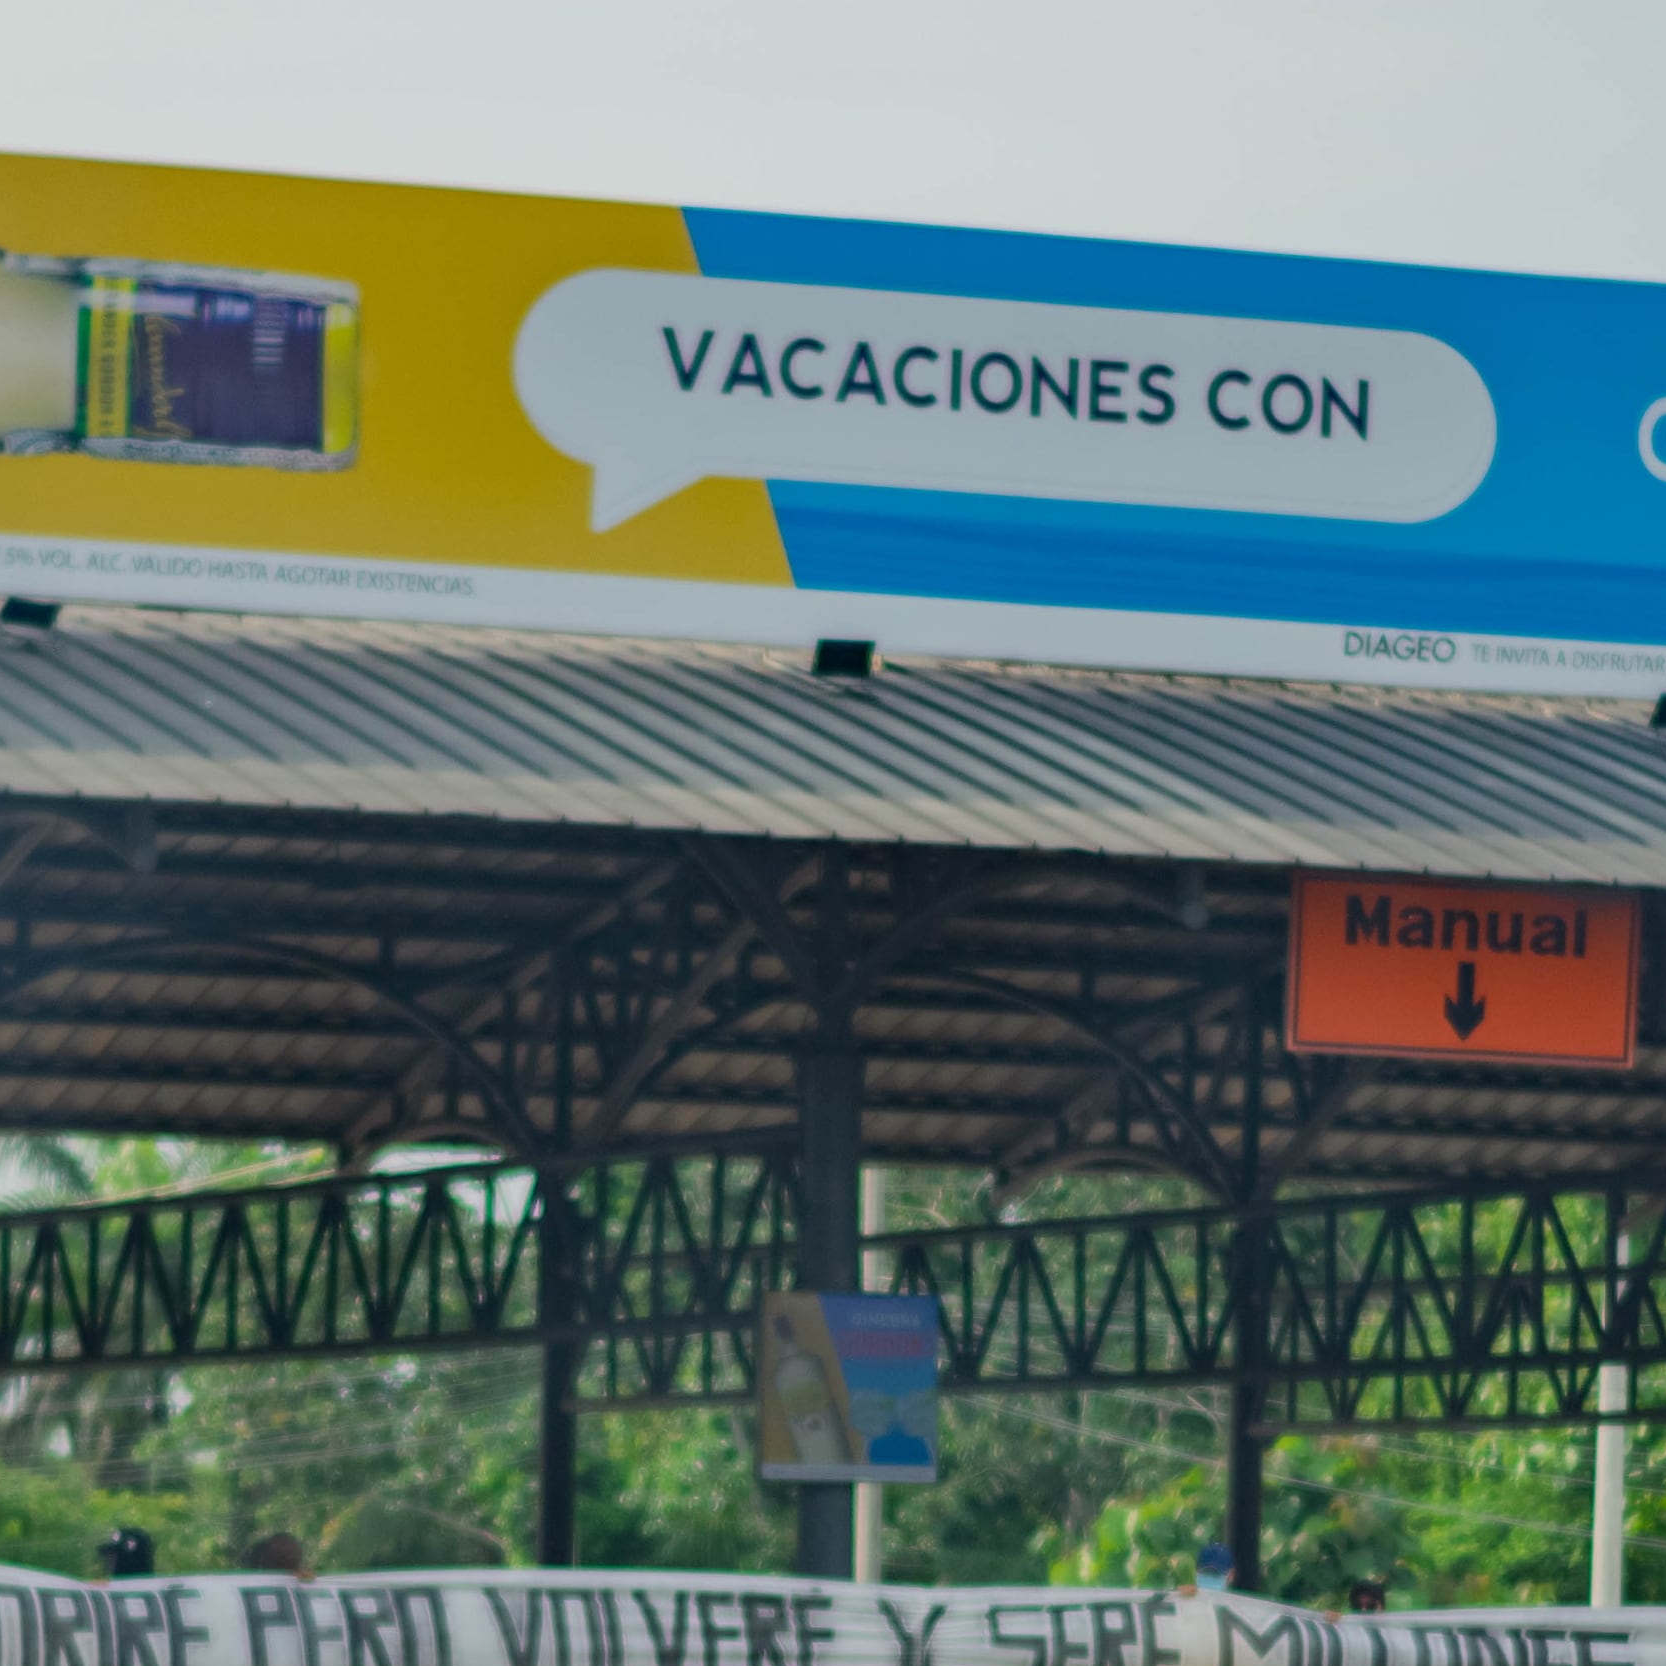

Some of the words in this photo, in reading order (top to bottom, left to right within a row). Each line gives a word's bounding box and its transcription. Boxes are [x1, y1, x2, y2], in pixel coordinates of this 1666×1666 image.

[662, 326, 1177, 426] VACACIONES
[1207, 368, 1371, 442] CON
[208, 558, 269, 582] HASTA
[274, 562, 351, 587] AGOTAR
[1343, 630, 1457, 665] DIAGEO
[1471, 642, 1490, 663] TE
[1496, 643, 1550, 667] INVITA
[1572, 648, 1666, 674] DISFRUTAR
[1344, 893, 1587, 958] Manual
